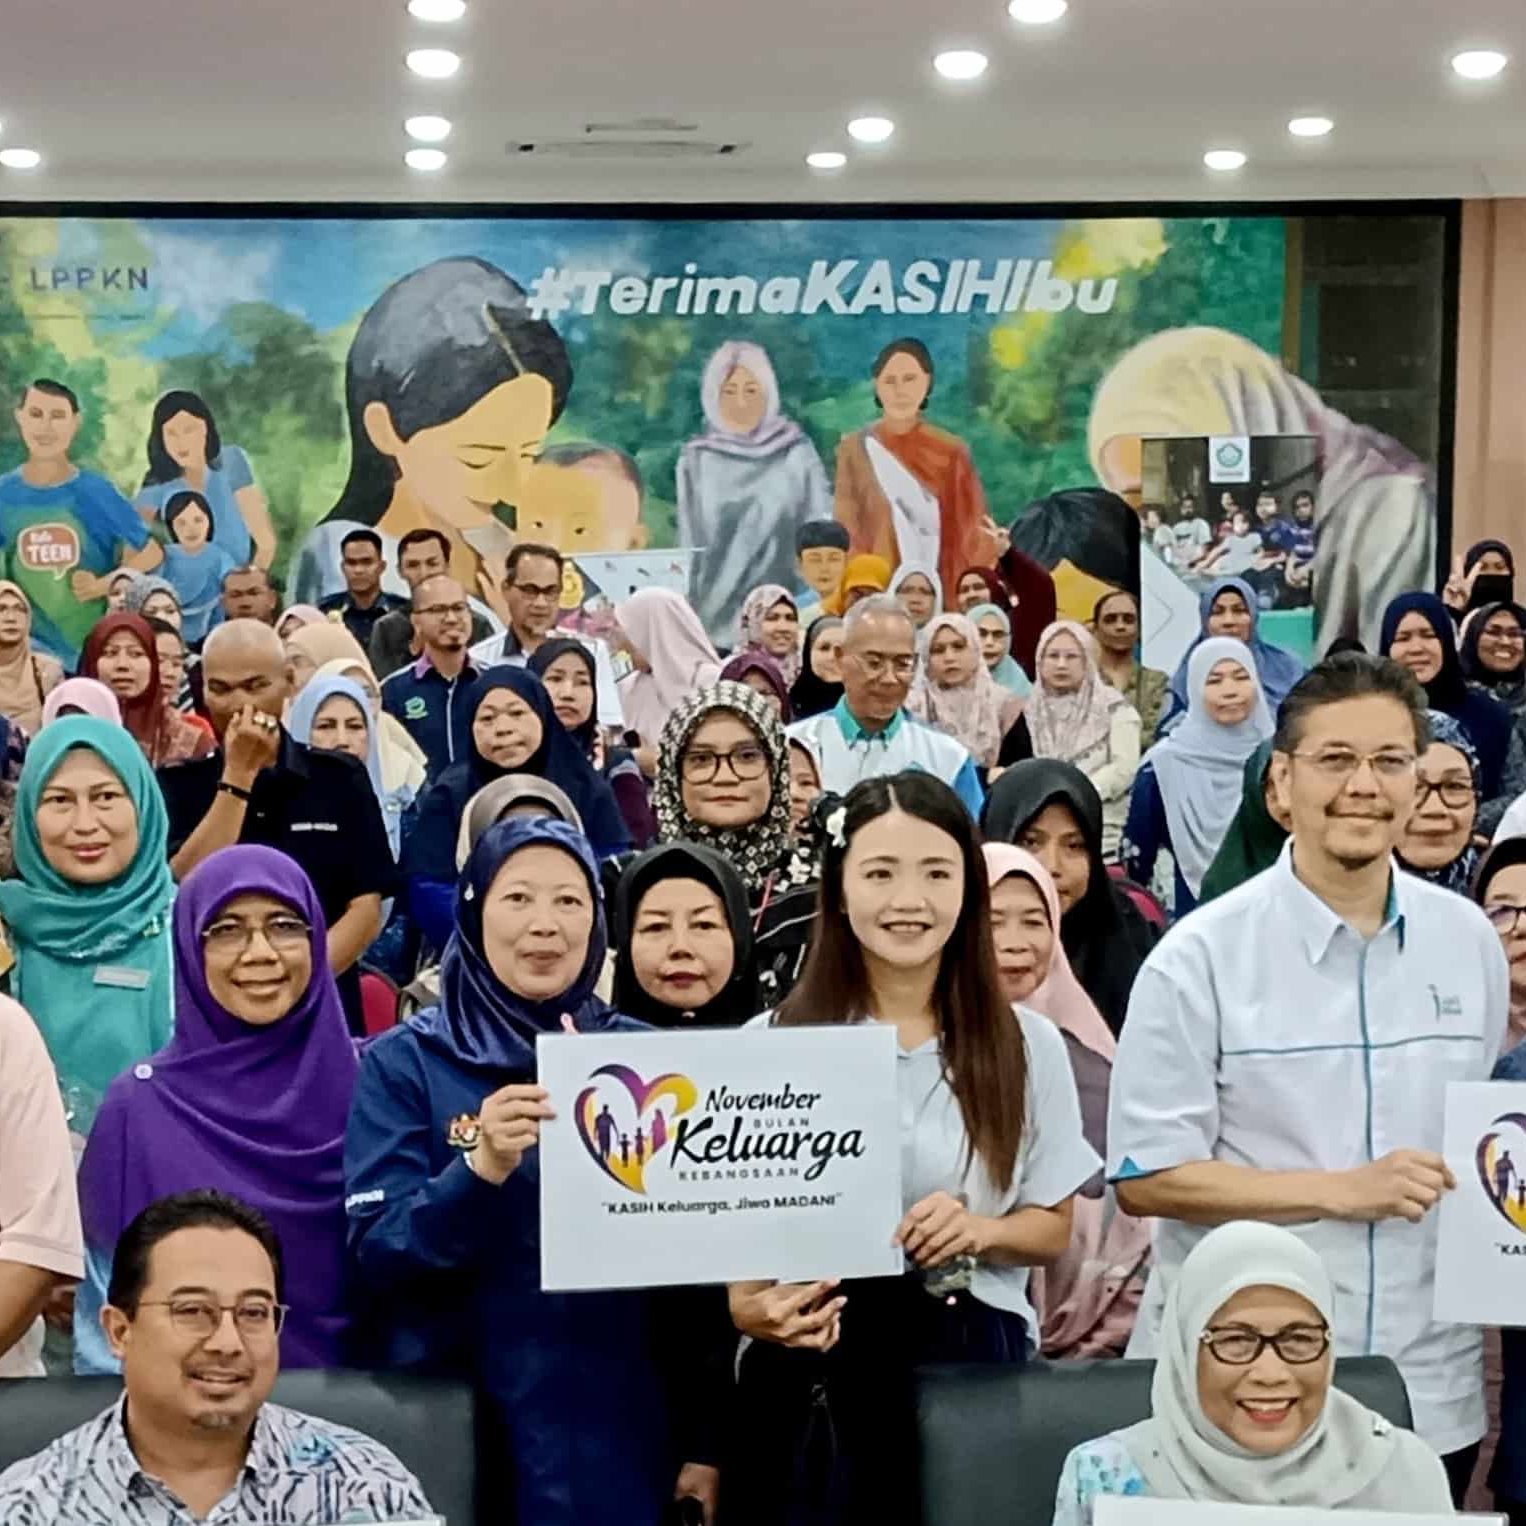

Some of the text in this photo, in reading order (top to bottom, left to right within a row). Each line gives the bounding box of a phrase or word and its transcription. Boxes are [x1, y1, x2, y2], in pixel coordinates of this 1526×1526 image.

[32, 267, 149, 291] LPPKN
[527, 259, 1119, 320] #TerimaKASIHIbu
[26, 544, 73, 563] TEEN
[705, 1083, 821, 1113] November
[754, 1118, 810, 1129] BULAN
[671, 1116, 865, 1181] Keluarga
[679, 1168, 800, 1181] KEBANGSAAN
[658, 1200, 731, 1215] Keluarga,
[735, 1198, 770, 1210] Jiwa
